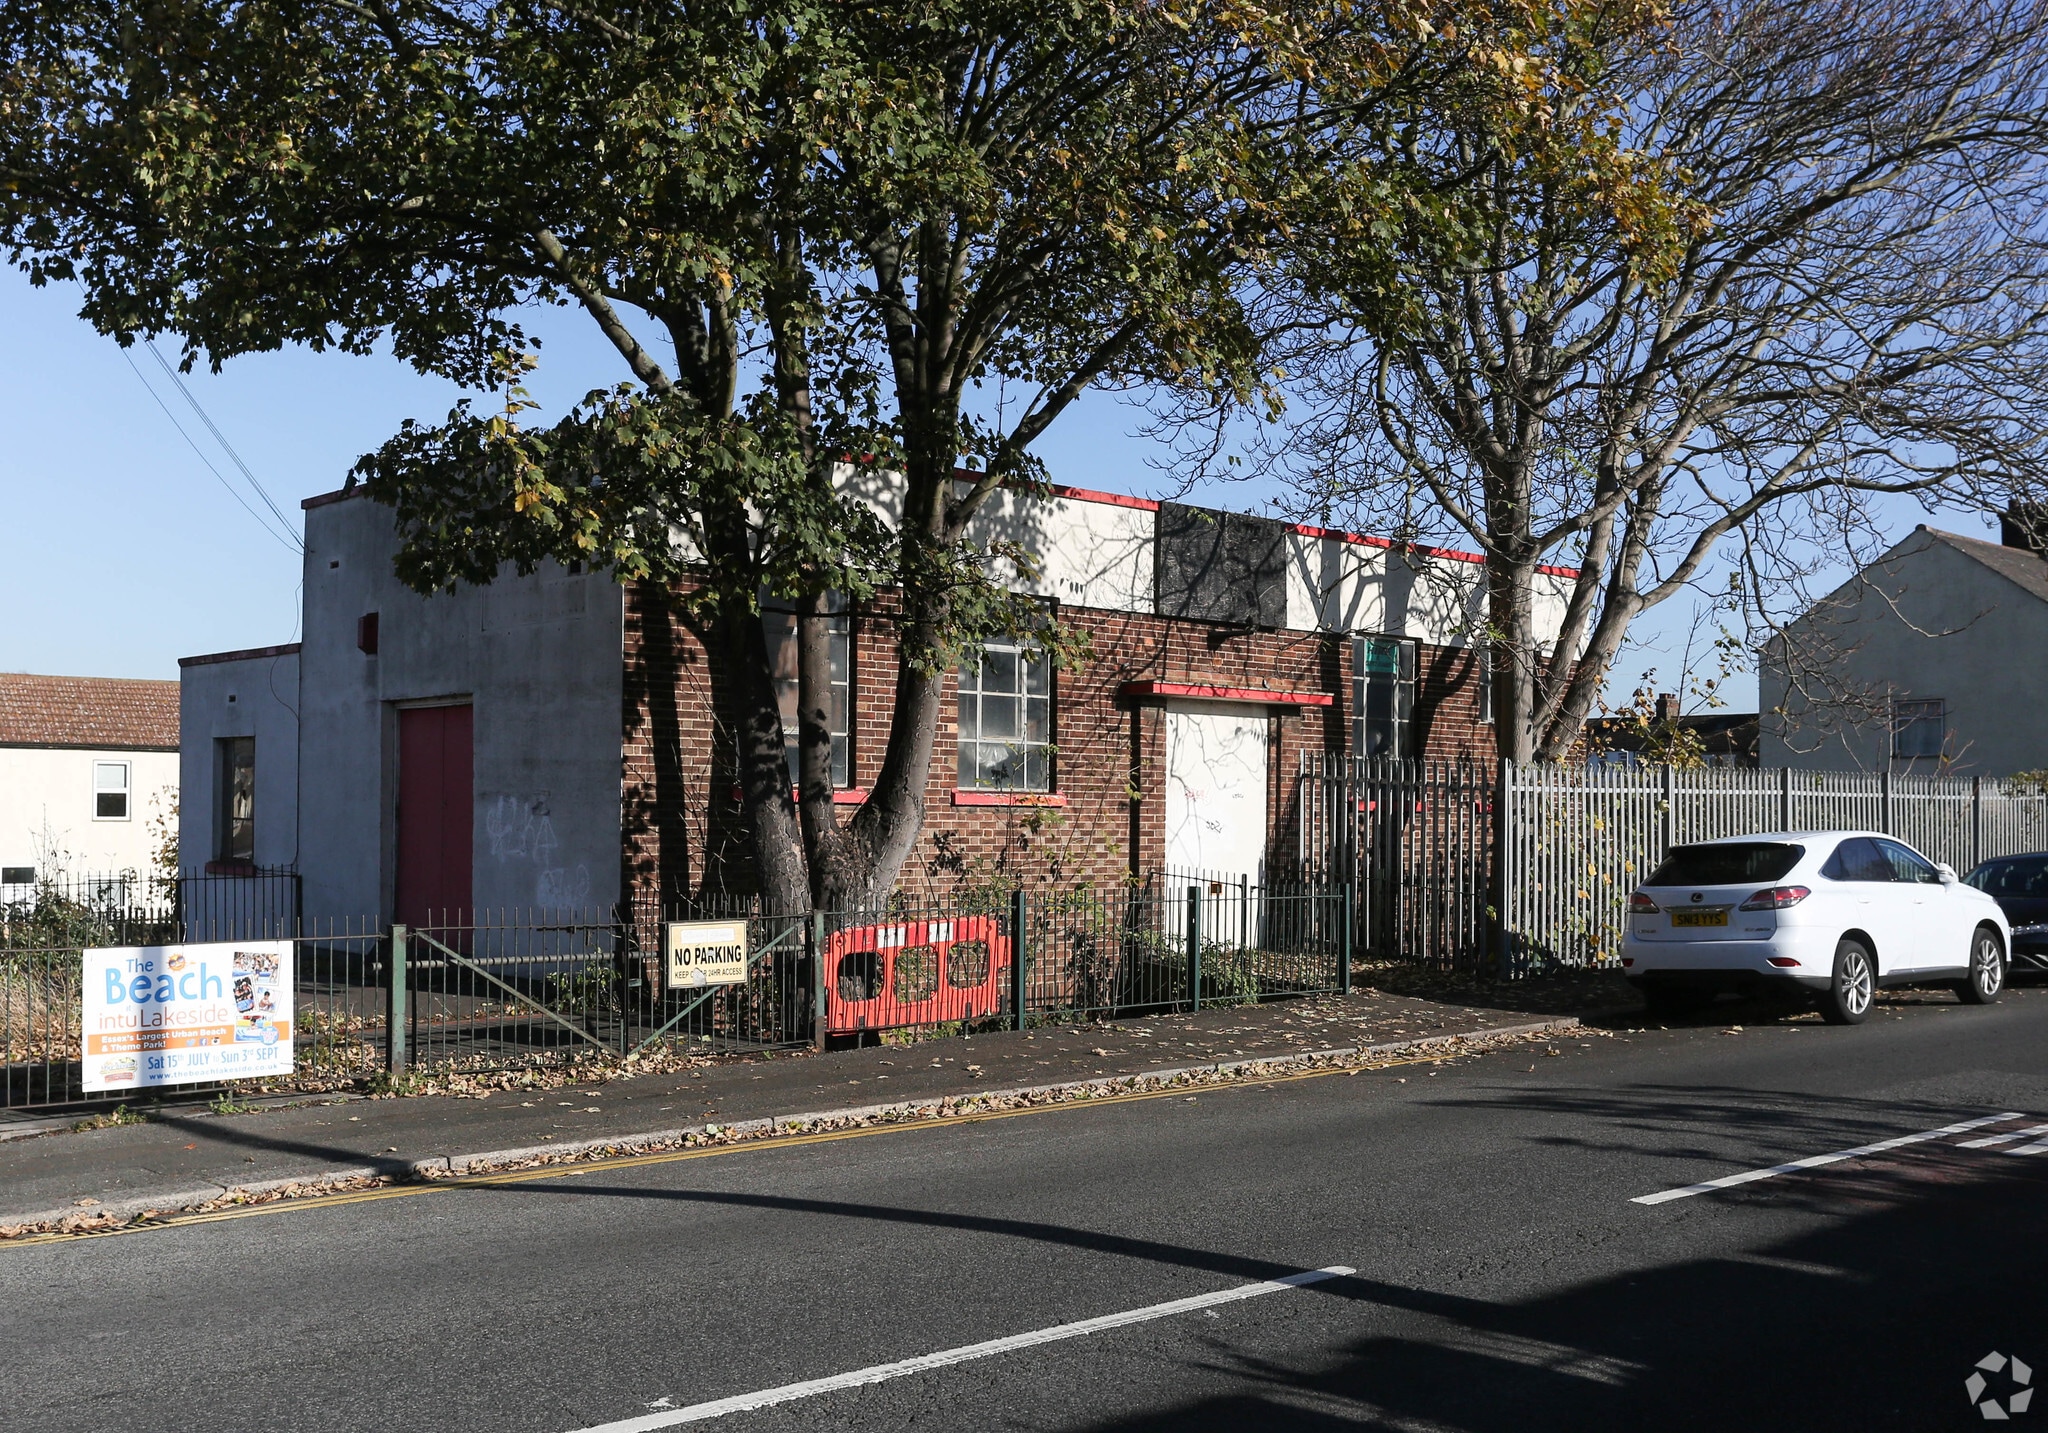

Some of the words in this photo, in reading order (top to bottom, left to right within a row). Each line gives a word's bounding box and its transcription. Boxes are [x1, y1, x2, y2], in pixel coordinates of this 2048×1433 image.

[1677, 914, 1699, 925] SN13
[1701, 914, 1721, 925] YYS
[675, 948, 691, 966] NO
[695, 945, 742, 965] PARKING
[126, 958, 154, 973] The
[675, 970, 689, 979] KEEP
[708, 968, 721, 977] 24HR
[722, 967, 742, 976] ACCESS
[105, 962, 222, 1004] Beach
[101, 1034, 134, 1044] Essex's
[136, 1032, 170, 1042] Largest
[171, 1029, 199, 1038] Urban
[200, 1027, 226, 1036] Beach
[110, 1043, 141, 1052] Theme
[143, 1041, 166, 1049] Park!
[148, 1056, 165, 1070] Sat
[187, 1052, 210, 1066] JULY
[221, 1051, 239, 1064] Sun
[256, 1047, 279, 1060] SEPT
[149, 1063, 277, 1080] www.thebeachlakeside.co.uk
